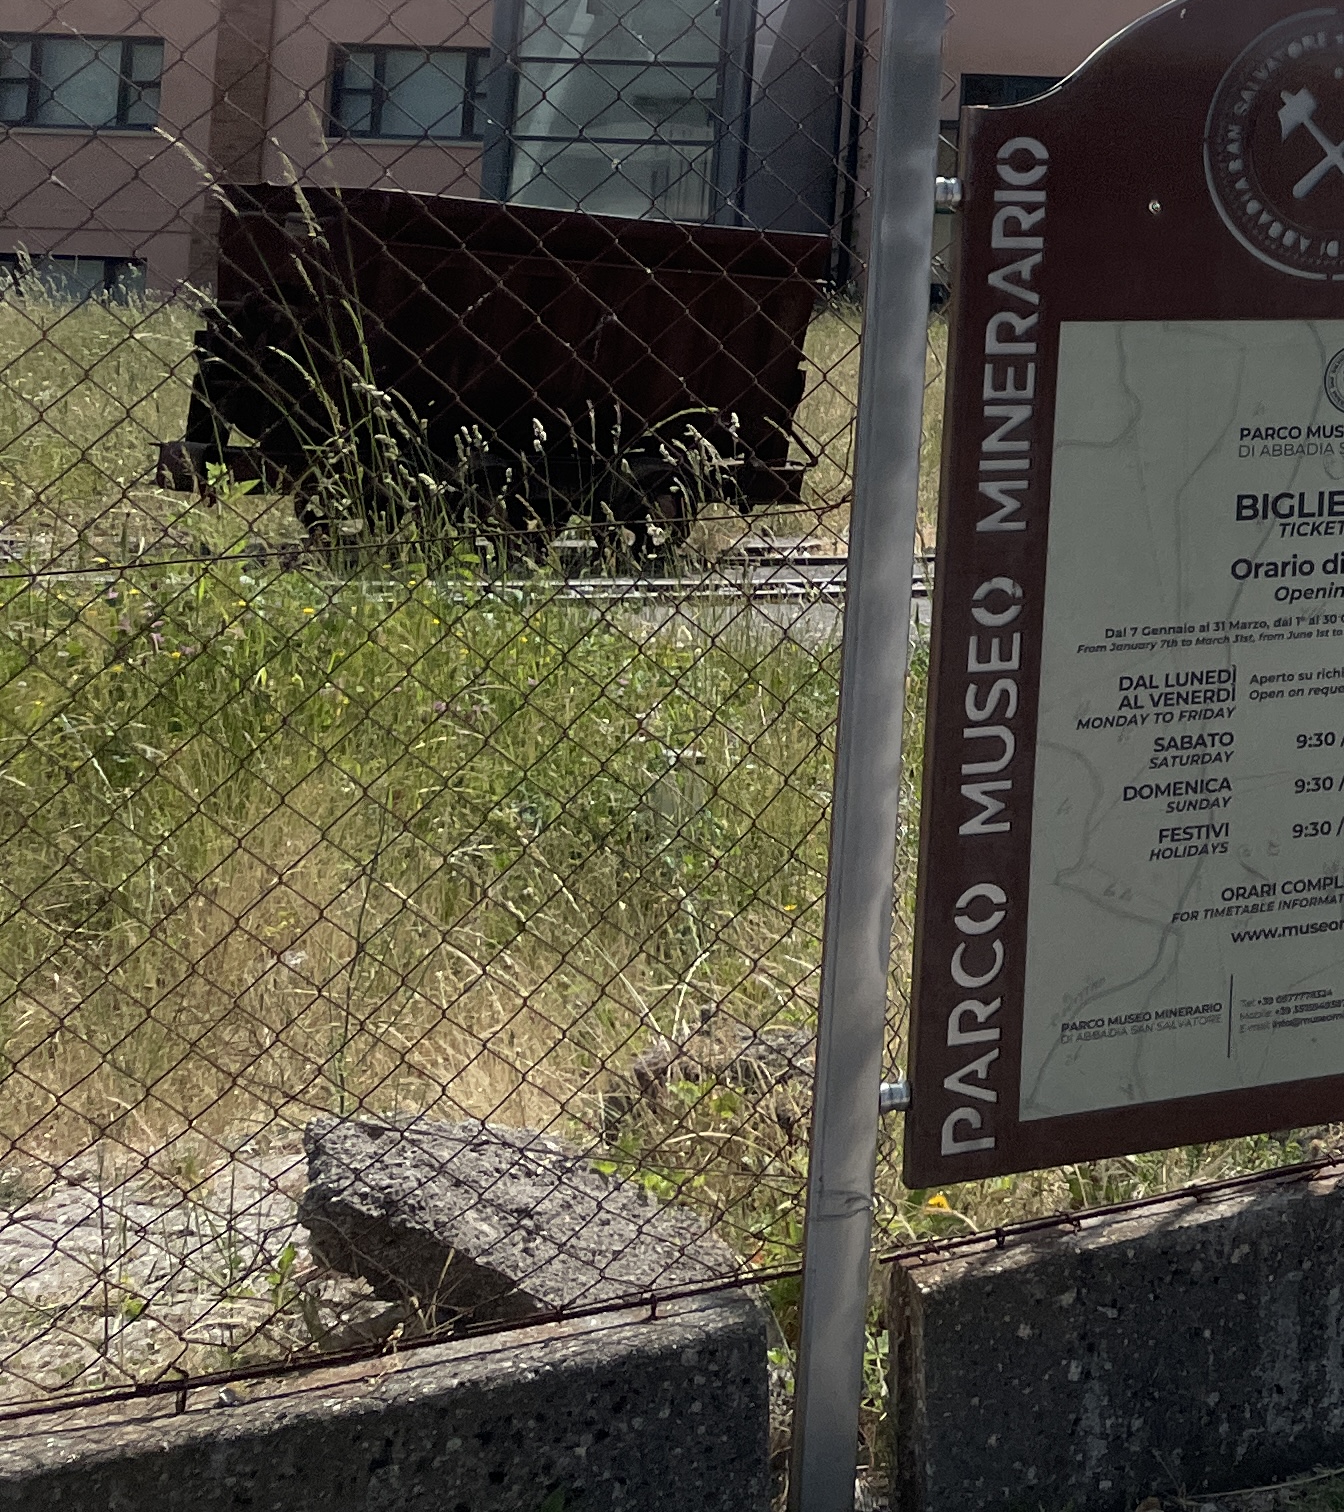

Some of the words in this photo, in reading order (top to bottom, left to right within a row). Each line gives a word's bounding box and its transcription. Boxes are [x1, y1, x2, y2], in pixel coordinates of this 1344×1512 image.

[976, 137, 1049, 532] MINERARIO
[1240, 425, 1301, 441] PARCO
[1238, 444, 1254, 458] DI
[1260, 441, 1334, 457] ABBADIA
[1231, 553, 1315, 580] Orario
[1105, 627, 1127, 639] Dal
[1130, 627, 1138, 637] 7
[1142, 623, 1195, 637] Gennaio
[1198, 622, 1210, 633] al
[1213, 621, 1225, 632] 31
[1228, 619, 1270, 631] Marzo,
[1273, 617, 1292, 629] dal
[1308, 615, 1320, 626] al
[1322, 614, 1337, 625] 30
[1077, 643, 1107, 654] From
[1109, 640, 1157, 652] January
[1160, 638, 1178, 648] 7th
[1181, 637, 1192, 647] to
[1195, 635, 1230, 646] March
[1258, 631, 1285, 642] from
[1287, 630, 1313, 640] June
[1316, 628, 1329, 638] 1st
[1332, 627, 1343, 636] to
[1119, 674, 1159, 692] DAL
[1164, 665, 1236, 689] LUNEDÌ
[1249, 671, 1295, 686] Aperto
[1297, 672, 1313, 682] su
[958, 576, 1023, 836] MUSEO
[1118, 693, 1145, 711] AL
[1149, 683, 1236, 707] VENERDÌ
[1249, 689, 1284, 703] Open
[1289, 687, 1304, 698] on
[1076, 712, 1150, 730] MONDAY
[1154, 710, 1174, 724] TO
[1178, 705, 1236, 722] FRIDAY
[1153, 731, 1234, 752] SABATO
[1296, 731, 1336, 749] 9:30
[1149, 750, 1234, 769] SATURDAY
[1122, 777, 1232, 802] DOMENICA
[1294, 775, 1334, 794] 9:30
[1165, 796, 1232, 813] SUNDAY
[1159, 822, 1230, 843] FESTIVI
[1292, 820, 1332, 838] 9:30
[1149, 841, 1229, 862] HOLIDAYS
[1221, 882, 1277, 902] ORARI
[1171, 910, 1199, 924] FOR
[1203, 900, 1275, 919] TIMETABLE
[941, 882, 1007, 1156] PARCO
[1060, 1018, 1105, 1033] PARCO
[1108, 1011, 1152, 1026] MUSEO
[1155, 1002, 1223, 1020] MINERARIO
